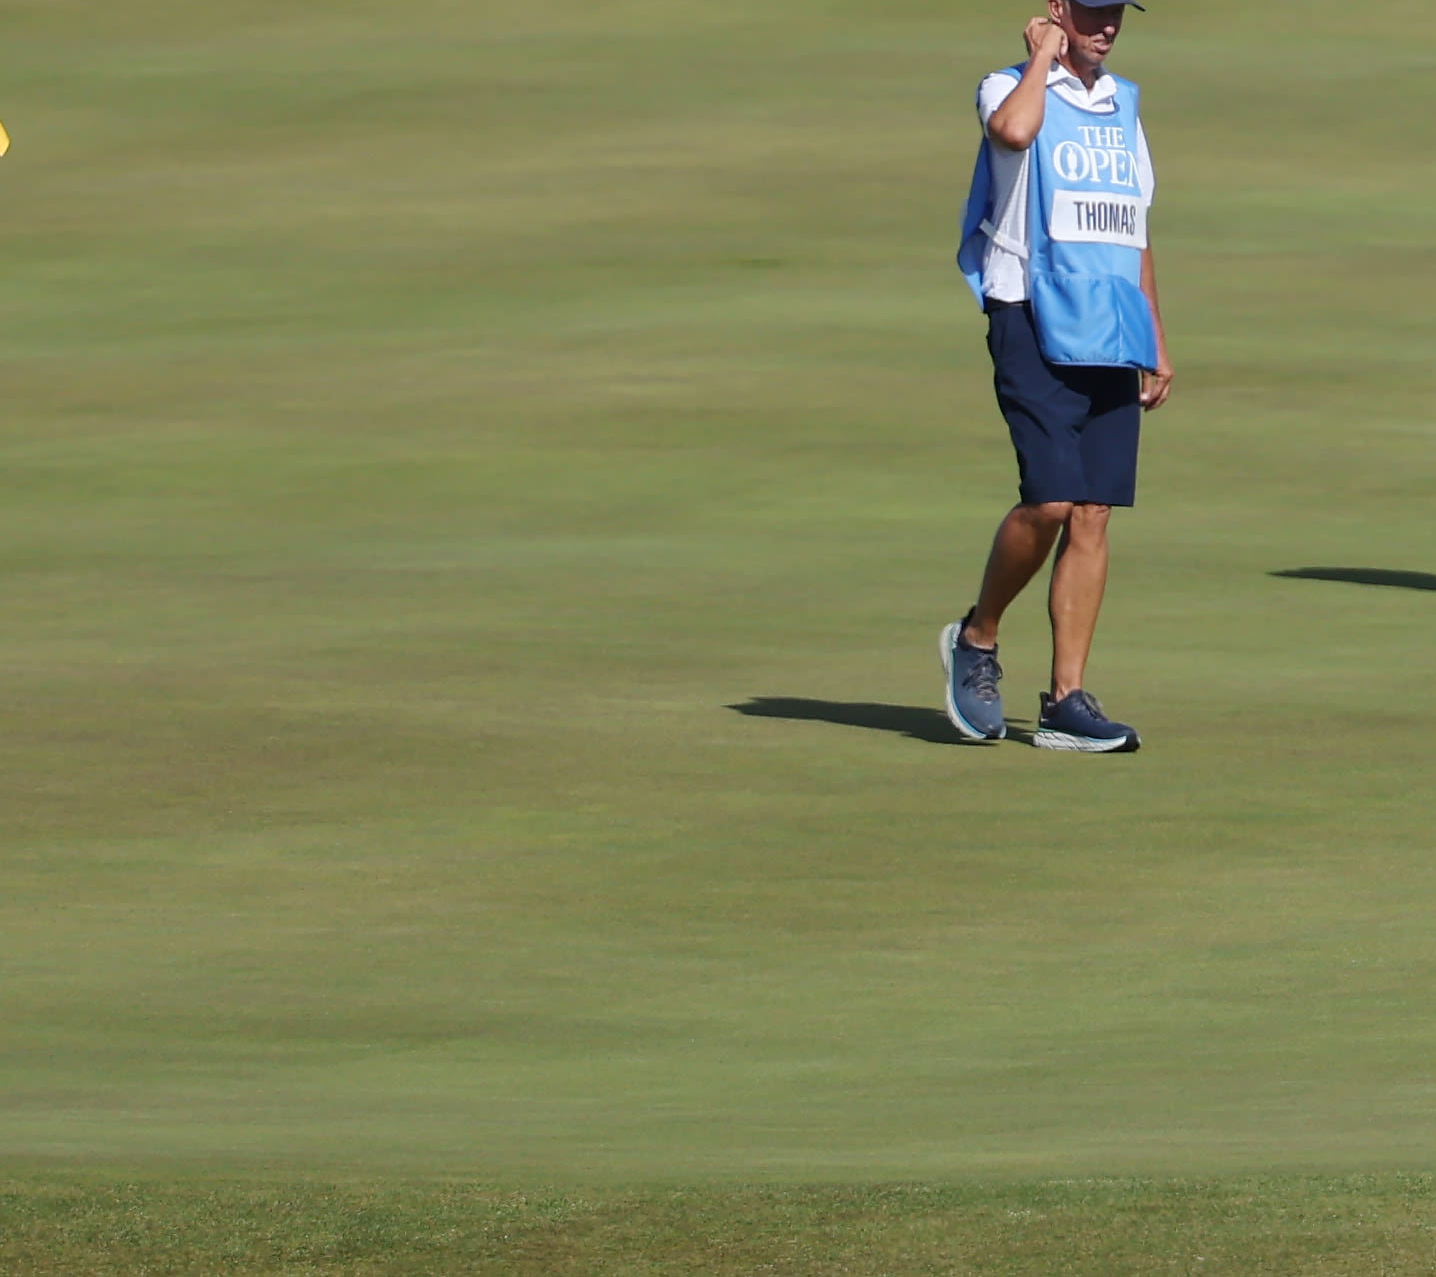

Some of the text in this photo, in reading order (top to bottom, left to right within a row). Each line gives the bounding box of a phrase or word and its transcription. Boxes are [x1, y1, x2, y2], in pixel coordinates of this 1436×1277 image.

[1078, 126, 1126, 148] THE
[1053, 140, 1141, 189] OPEN
[1073, 201, 1136, 236] THOMAS
